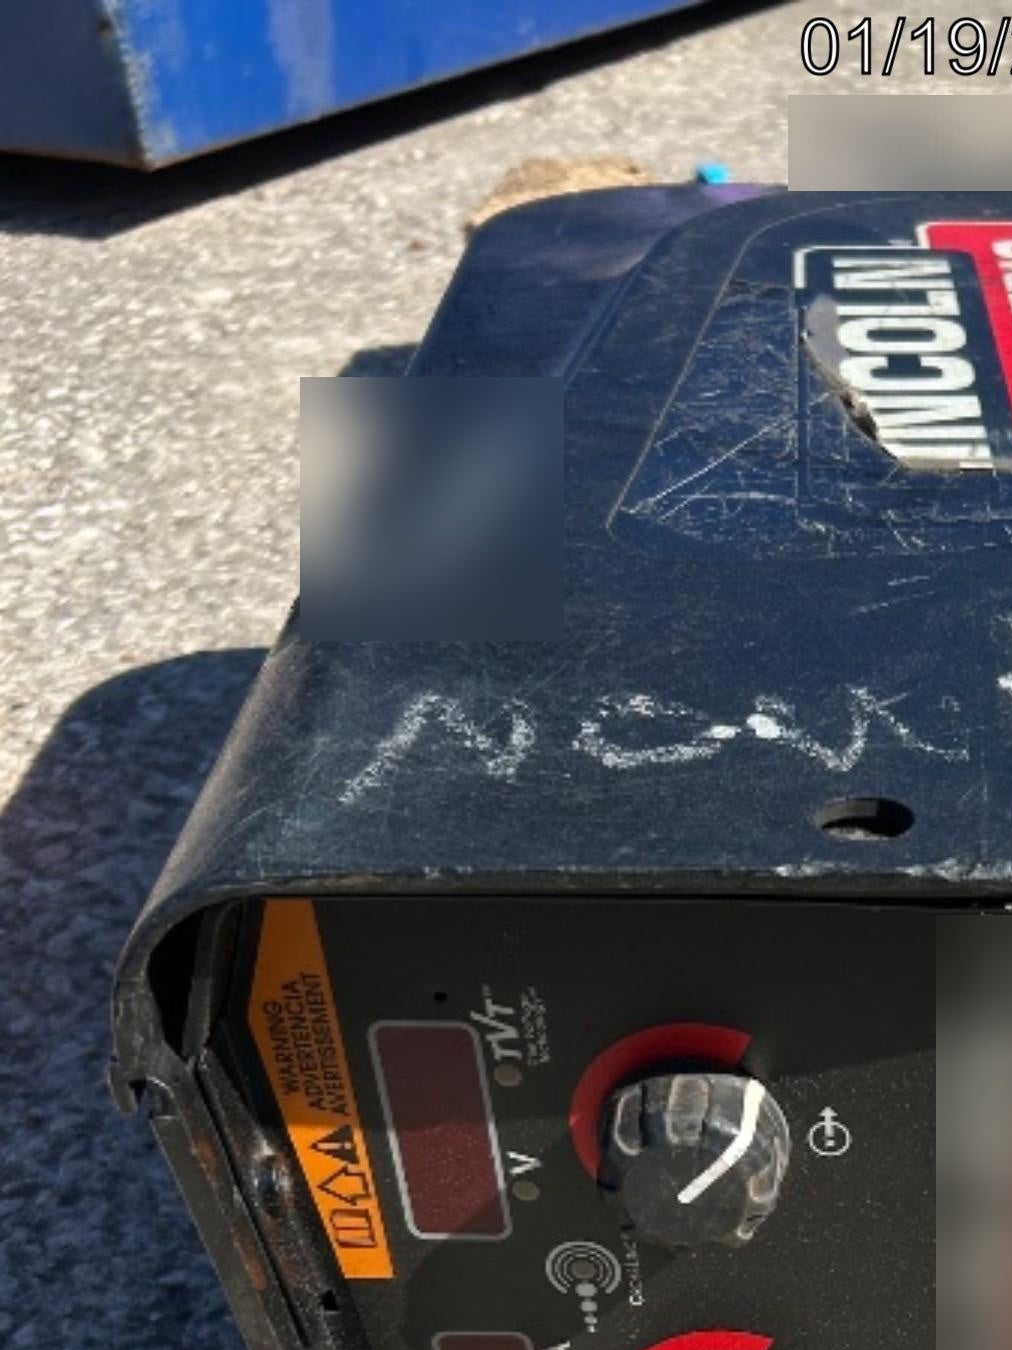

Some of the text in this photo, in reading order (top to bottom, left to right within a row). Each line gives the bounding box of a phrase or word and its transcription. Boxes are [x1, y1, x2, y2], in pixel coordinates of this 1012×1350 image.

[832, 256, 994, 467] INCOLN
[263, 999, 300, 1096] WARNING
[281, 979, 326, 1111] ADVERTENCIA
[506, 1151, 542, 1175] V
